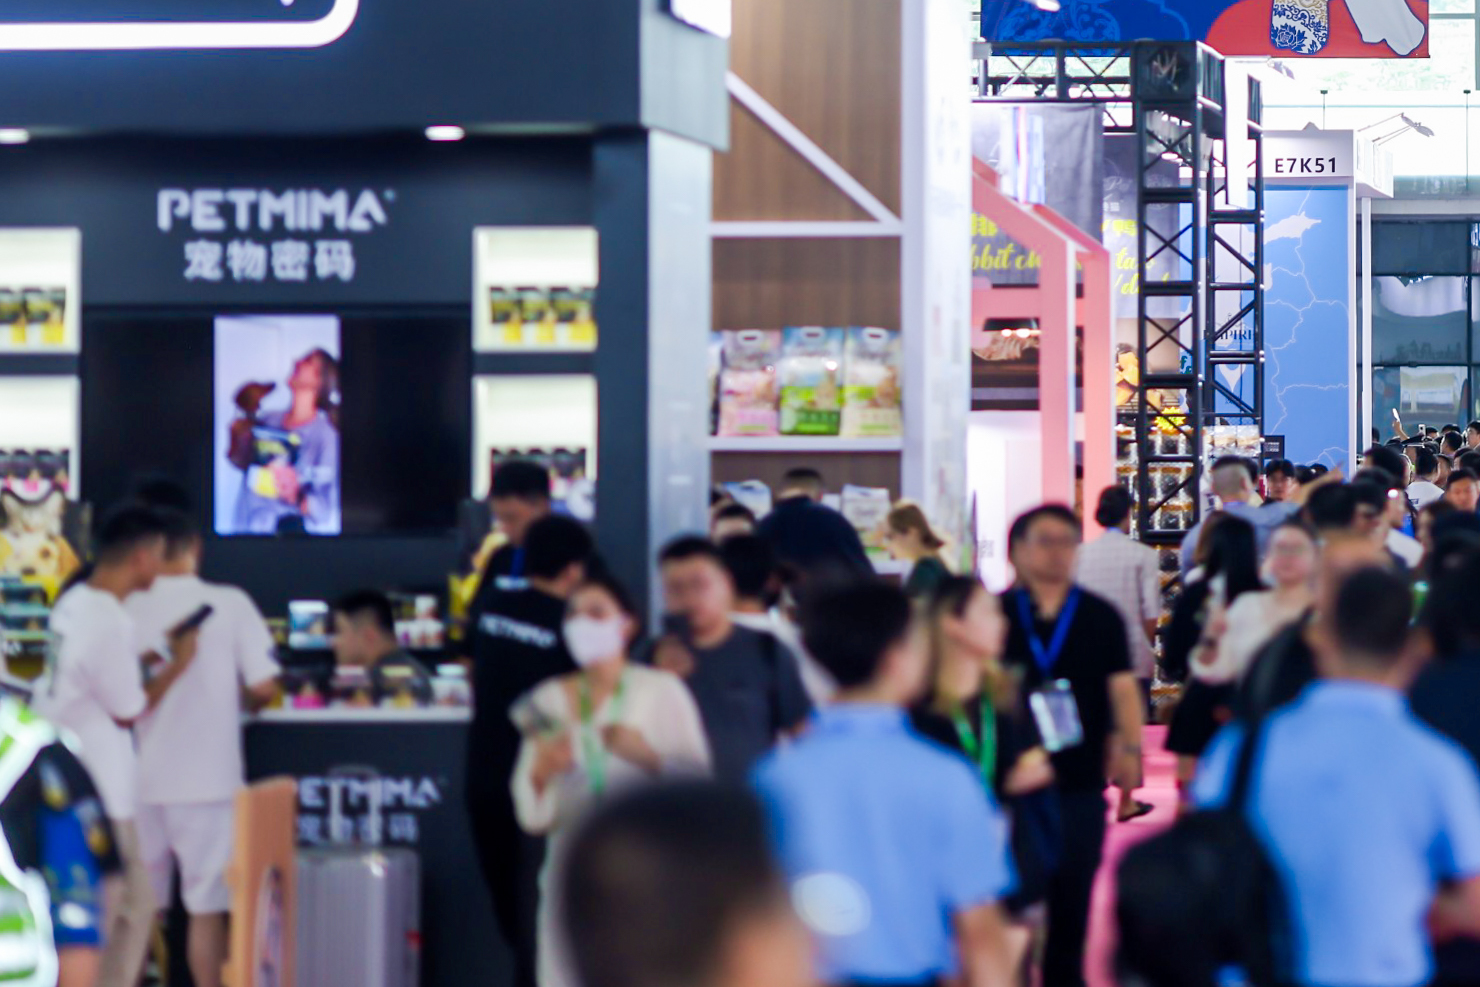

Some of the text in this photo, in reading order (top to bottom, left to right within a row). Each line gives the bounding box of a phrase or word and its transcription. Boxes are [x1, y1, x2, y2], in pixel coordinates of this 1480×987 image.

[1275, 157, 1336, 173] E7K51
[157, 188, 387, 232] PETMIMA
[184, 239, 355, 282] 宠物密码
